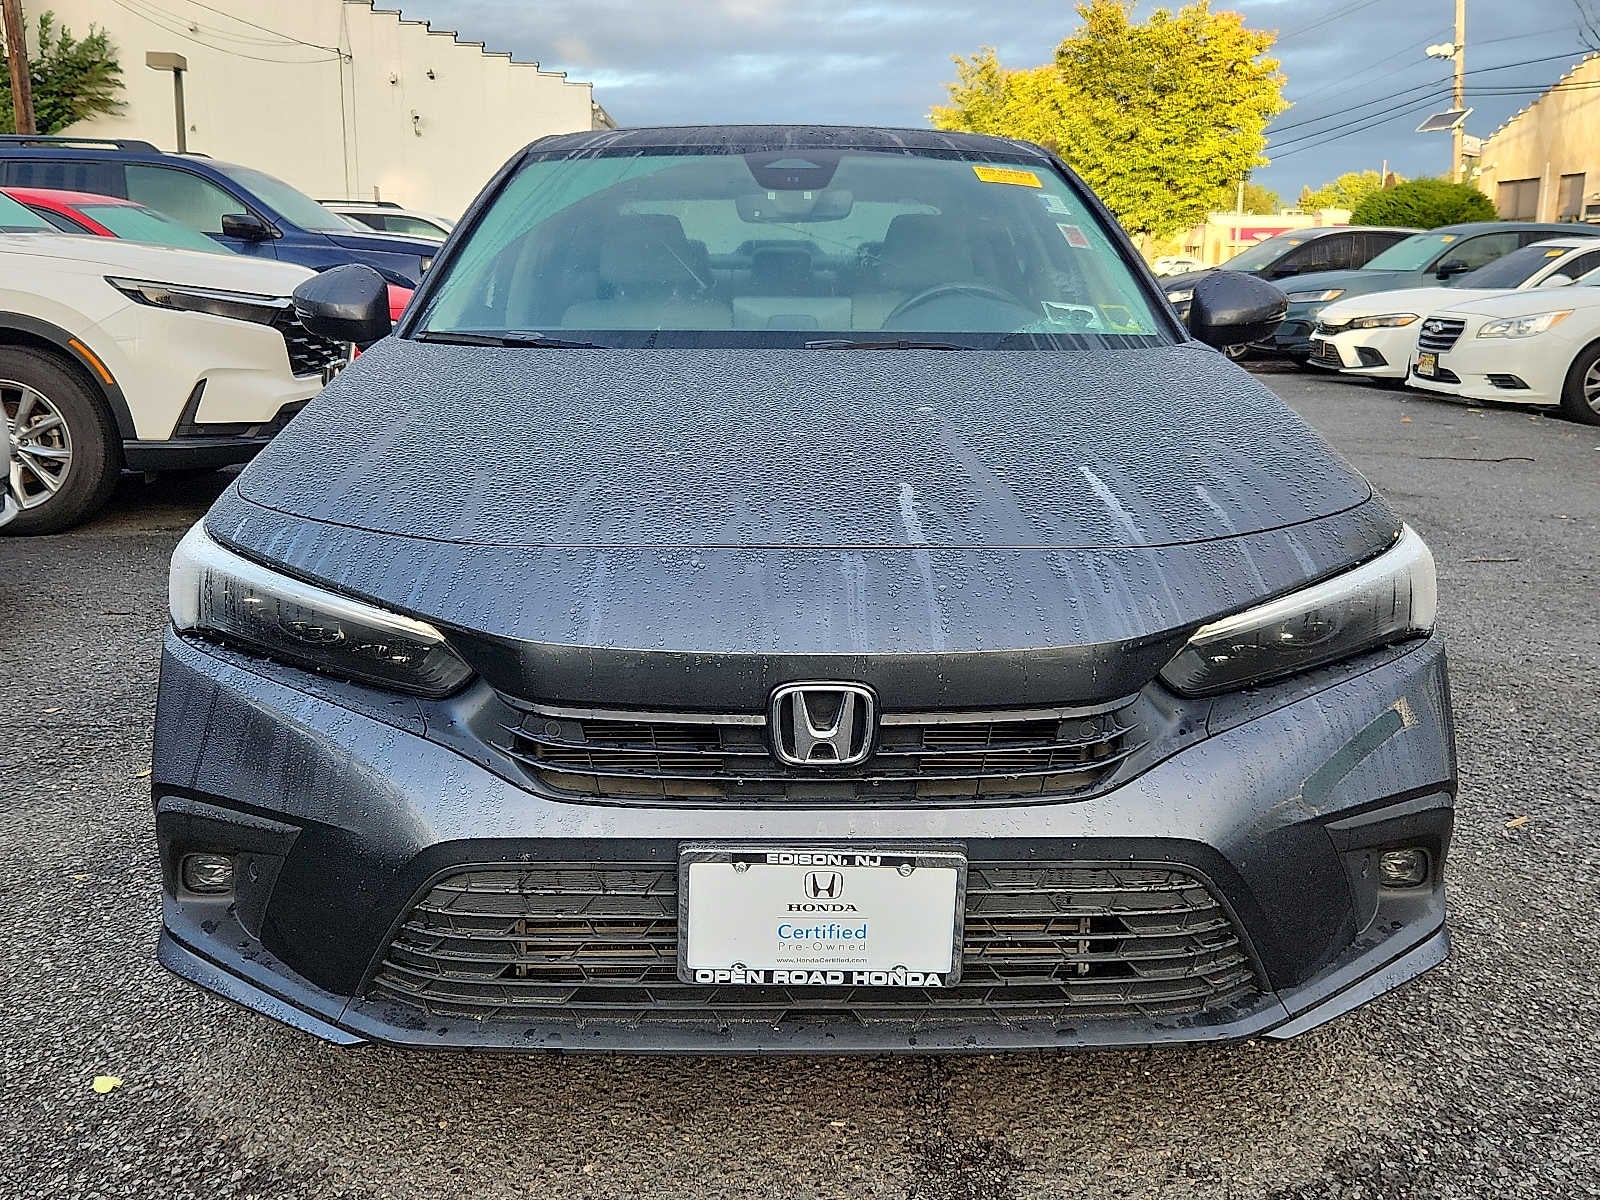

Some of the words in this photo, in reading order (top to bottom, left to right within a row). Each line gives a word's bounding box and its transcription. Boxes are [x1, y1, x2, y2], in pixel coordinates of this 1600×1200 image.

[766, 853, 848, 866] EDISON,
[855, 855, 882, 867] NJ
[786, 903, 858, 912] HONDA
[777, 923, 867, 939] Certified
[778, 941, 866, 951] Pre-Owned
[695, 969, 765, 984] OPEN
[773, 970, 845, 985] ROAD
[852, 971, 943, 987] HONDA
